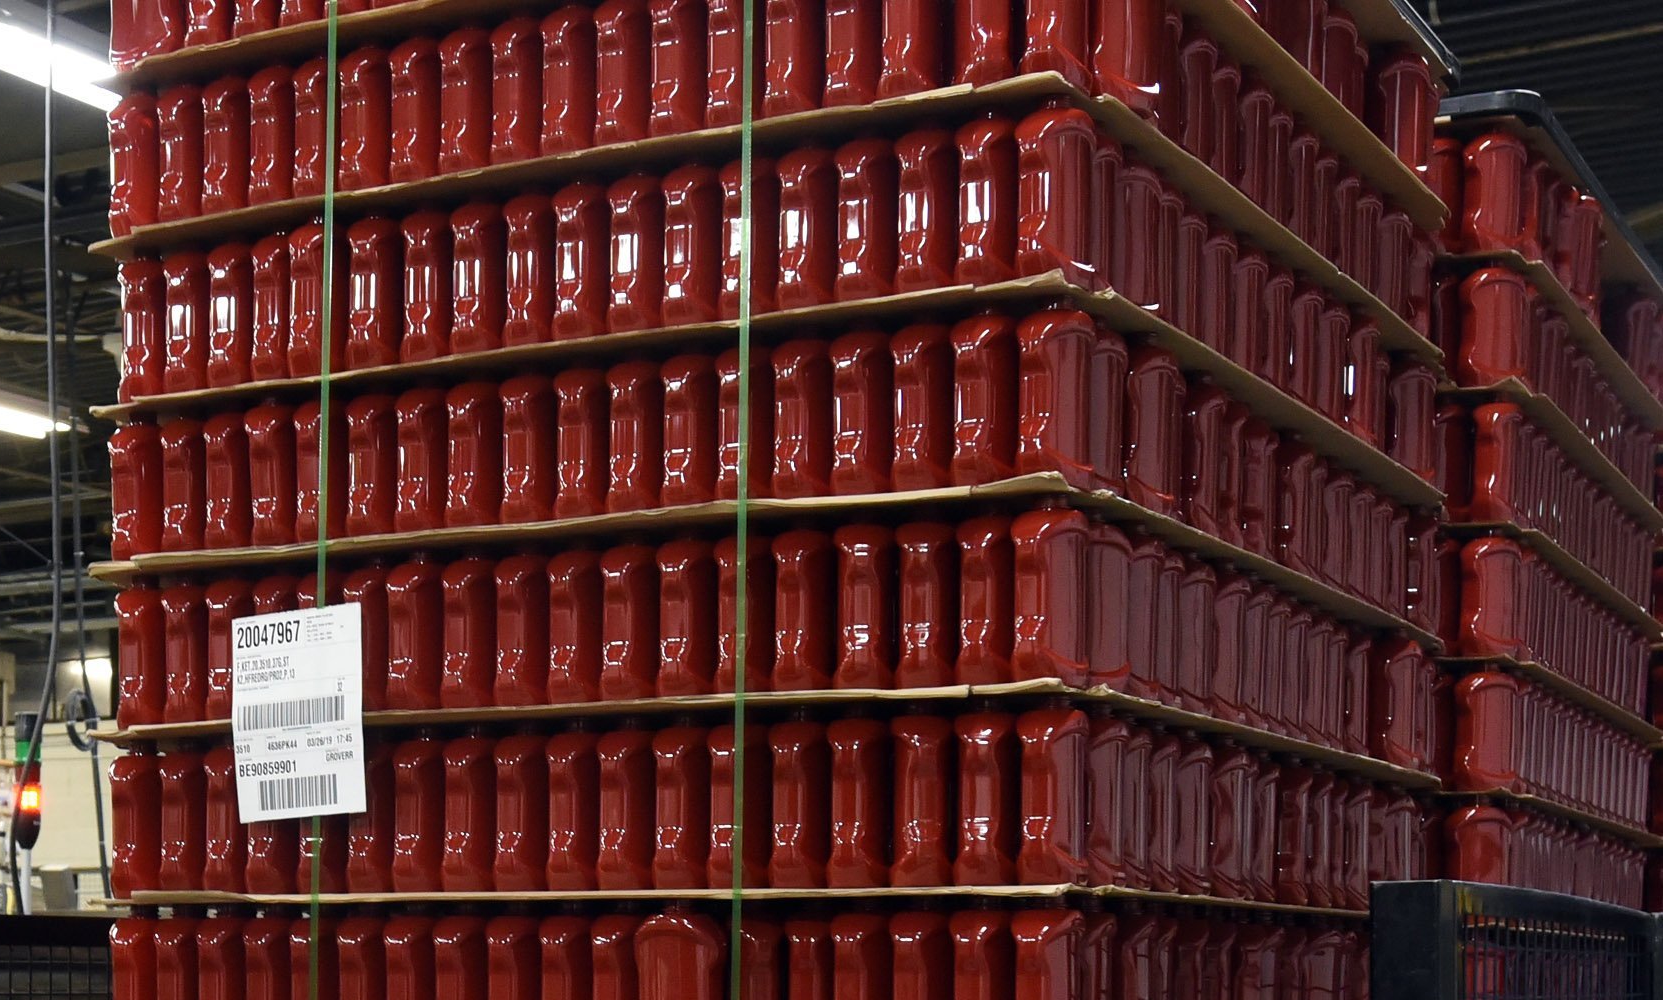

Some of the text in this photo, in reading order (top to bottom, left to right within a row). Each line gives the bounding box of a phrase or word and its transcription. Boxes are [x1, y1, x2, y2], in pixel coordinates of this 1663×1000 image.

[237, 620, 300, 648] 20047967
[307, 736, 332, 748] 03/26/19
[337, 734, 352, 744] 17:45
[236, 743, 251, 754] 3510
[239, 760, 297, 777] BE90859901
